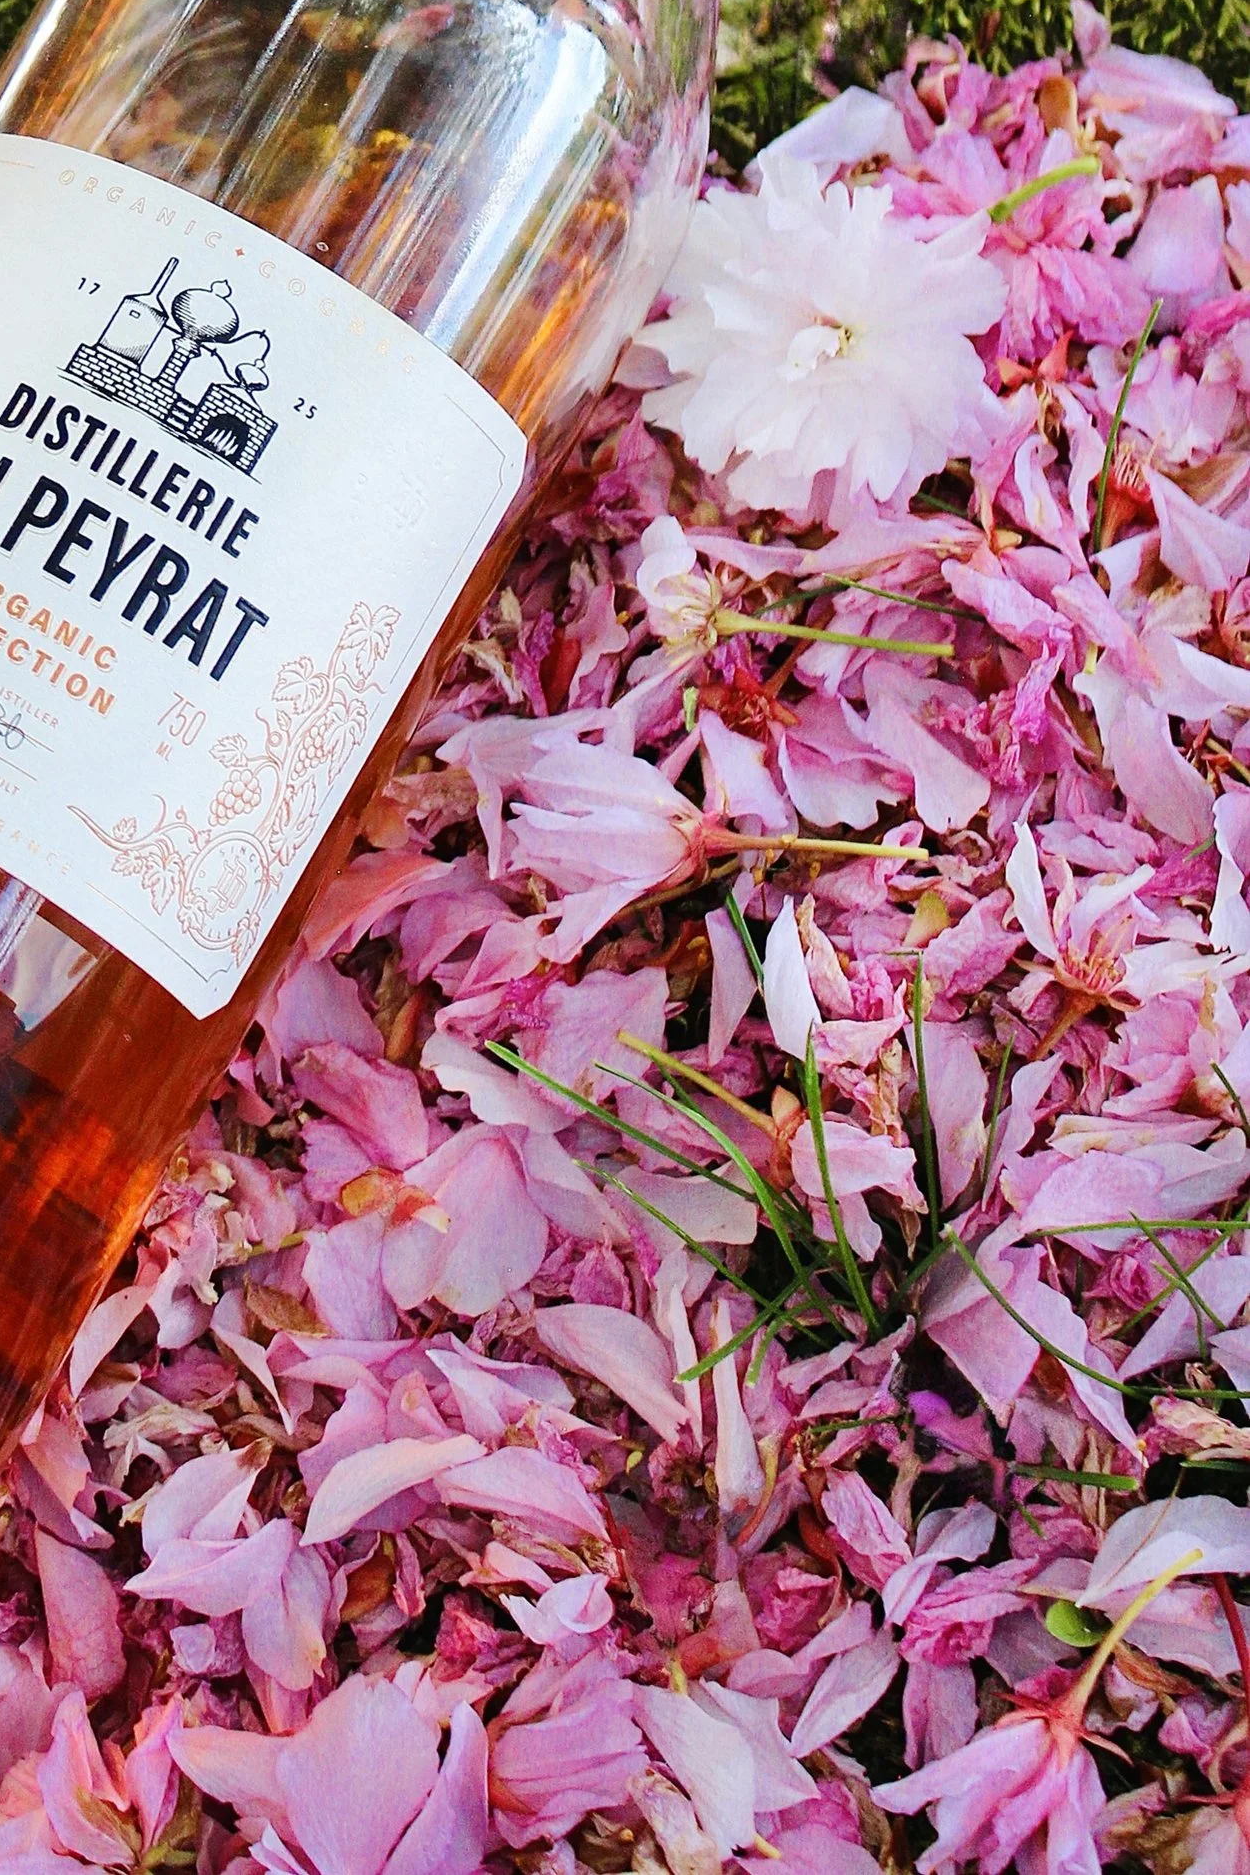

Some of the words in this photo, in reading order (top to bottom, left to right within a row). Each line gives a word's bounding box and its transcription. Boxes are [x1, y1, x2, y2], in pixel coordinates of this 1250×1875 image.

[59, 170, 221, 247] ORGANIC
[77, 277, 101, 296] 17
[292, 397, 318, 420] 25
[0, 476, 269, 681] PEYRAT
[157, 693, 207, 746] 750
